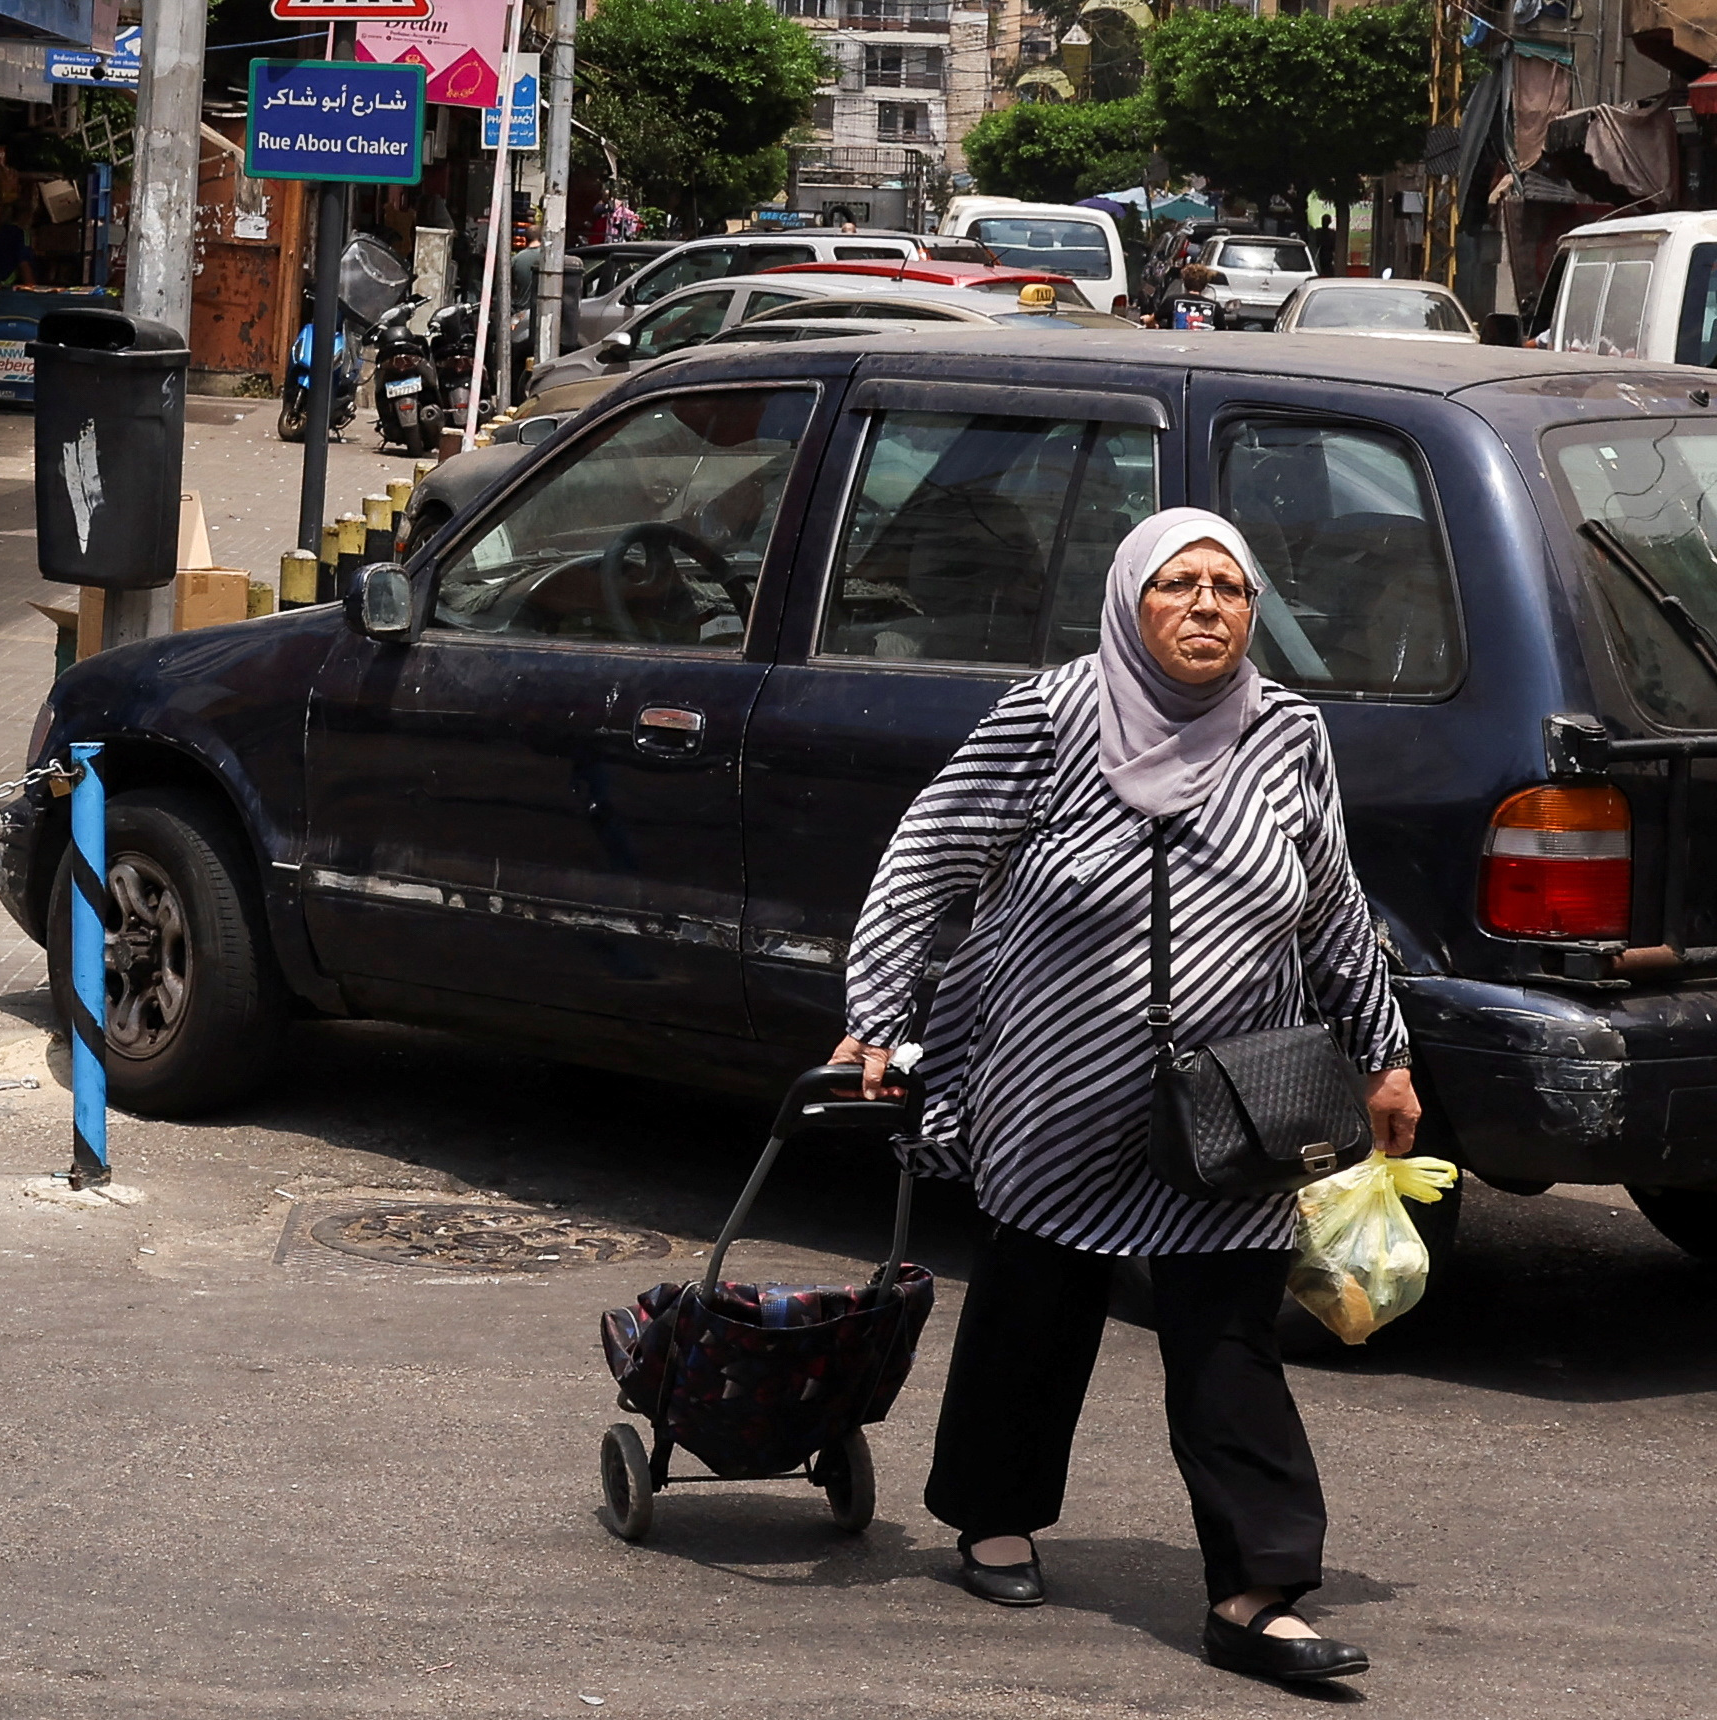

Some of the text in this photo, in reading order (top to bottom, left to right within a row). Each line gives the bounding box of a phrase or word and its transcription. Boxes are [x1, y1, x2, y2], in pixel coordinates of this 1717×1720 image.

[263, 84, 407, 117] شارع أبو شاكر
[258, 132, 408, 156] Rue Abou Chaker
[1035, 288, 1052, 302] TAXI
